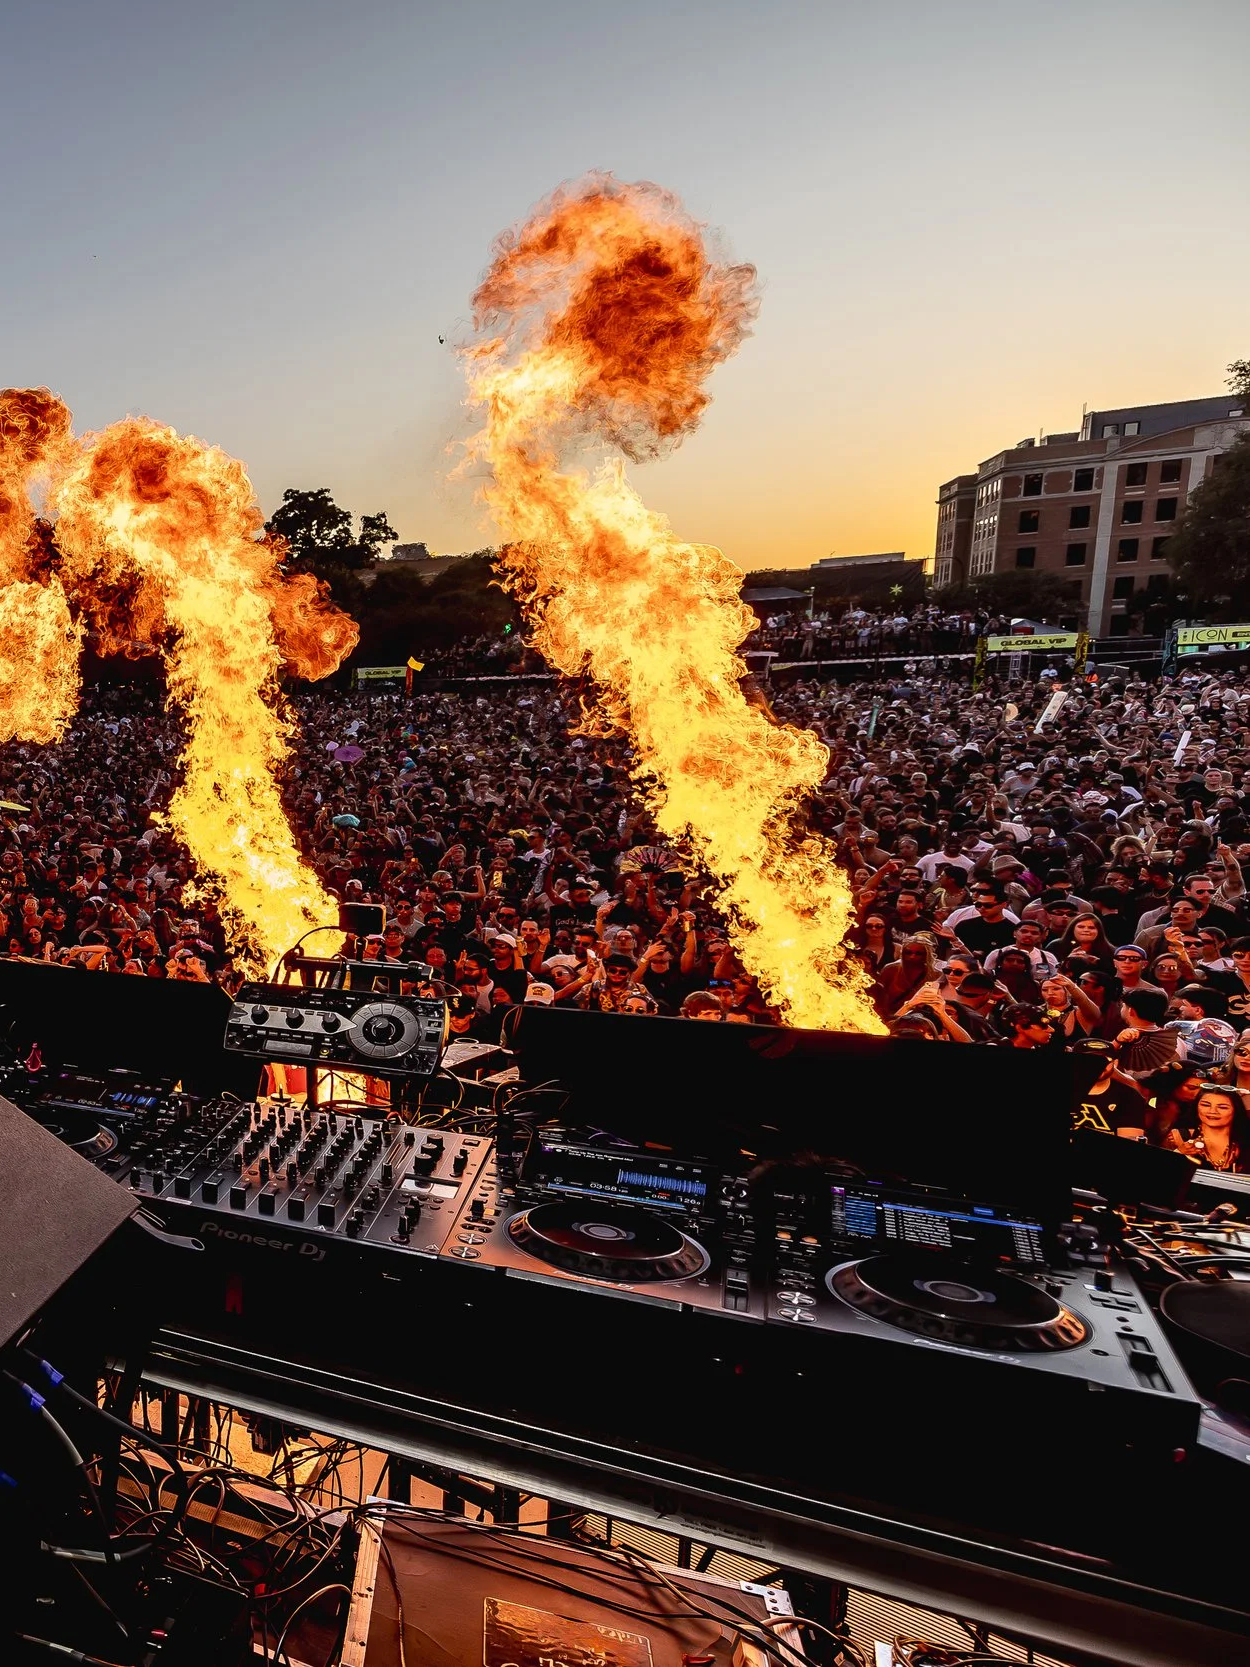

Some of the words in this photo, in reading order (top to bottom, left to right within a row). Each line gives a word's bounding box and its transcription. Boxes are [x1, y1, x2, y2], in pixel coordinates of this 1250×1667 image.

[1191, 628, 1228, 642] ICON
[1000, 639, 1045, 647] GLOBAL
[199, 1221, 294, 1251] Pioneer
[299, 1242, 327, 1261] DJ
